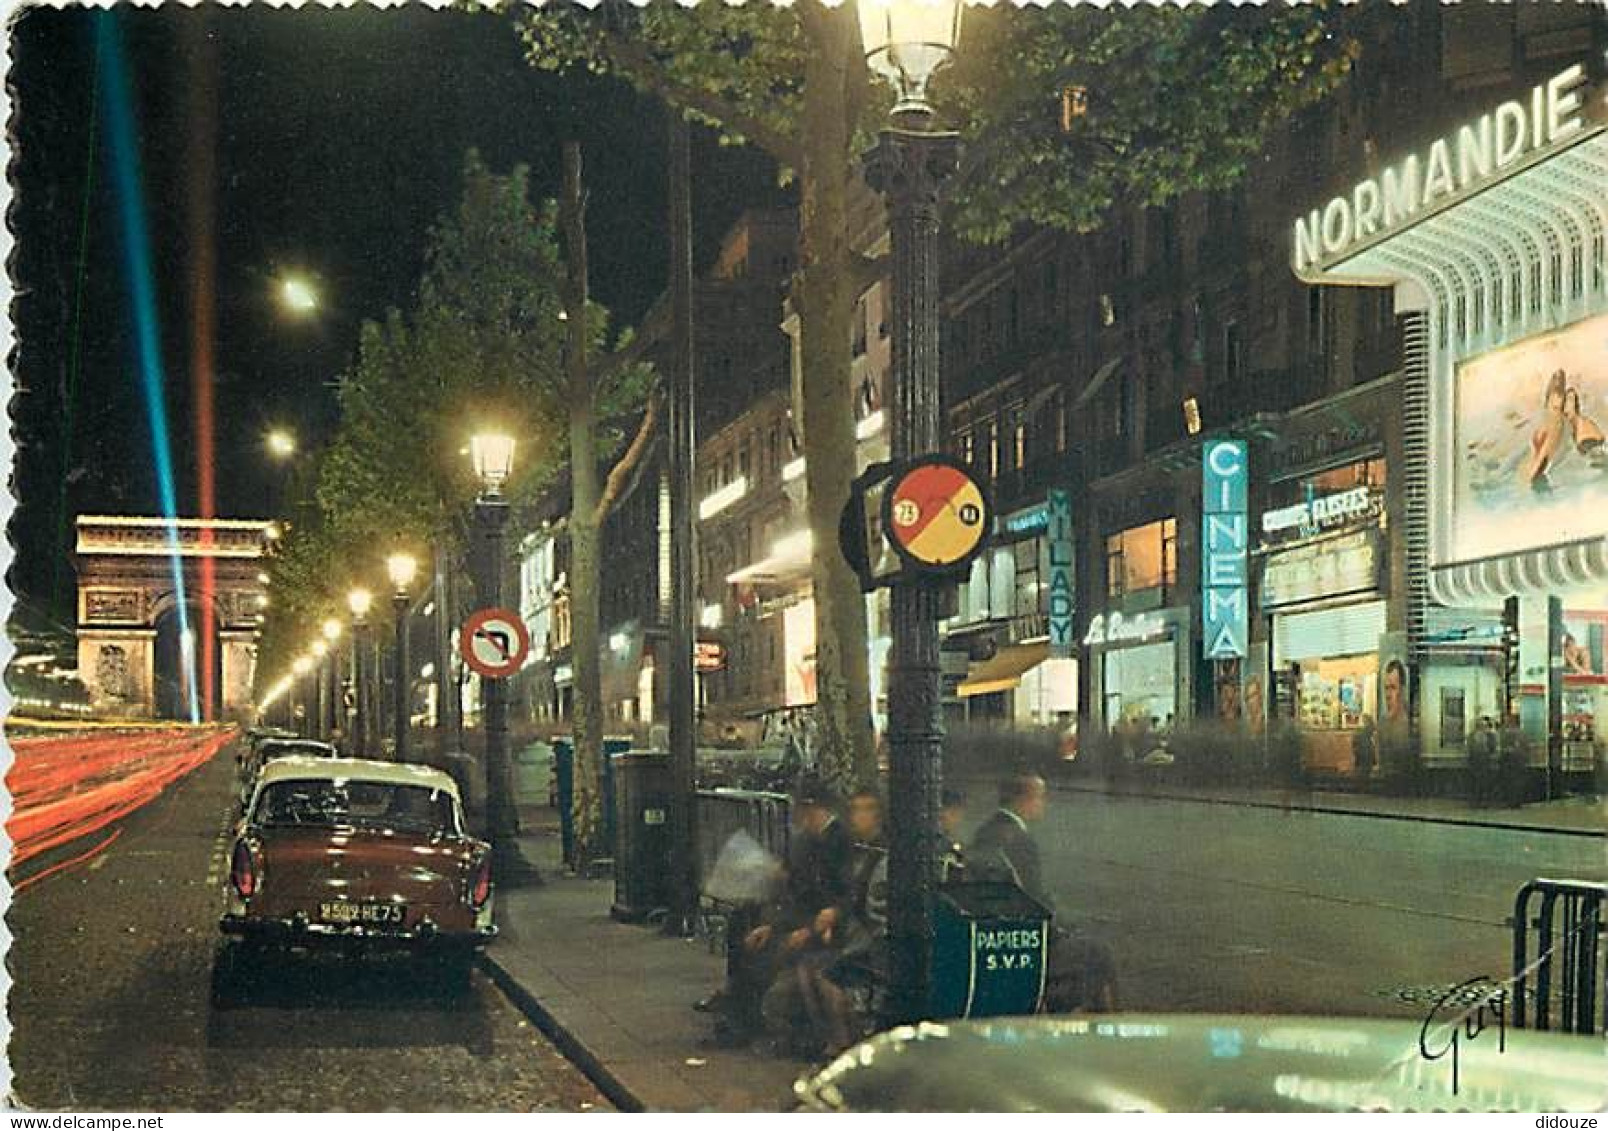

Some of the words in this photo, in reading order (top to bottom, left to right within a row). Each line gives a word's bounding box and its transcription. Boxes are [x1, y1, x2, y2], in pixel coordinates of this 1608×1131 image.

[1294, 63, 1586, 271] NORMANDIE
[1050, 489, 1072, 643] MILADY
[1209, 441, 1242, 657] CINEMA
[977, 930, 1040, 949] PAPIERS
[986, 954, 1034, 970] S.V.P.
